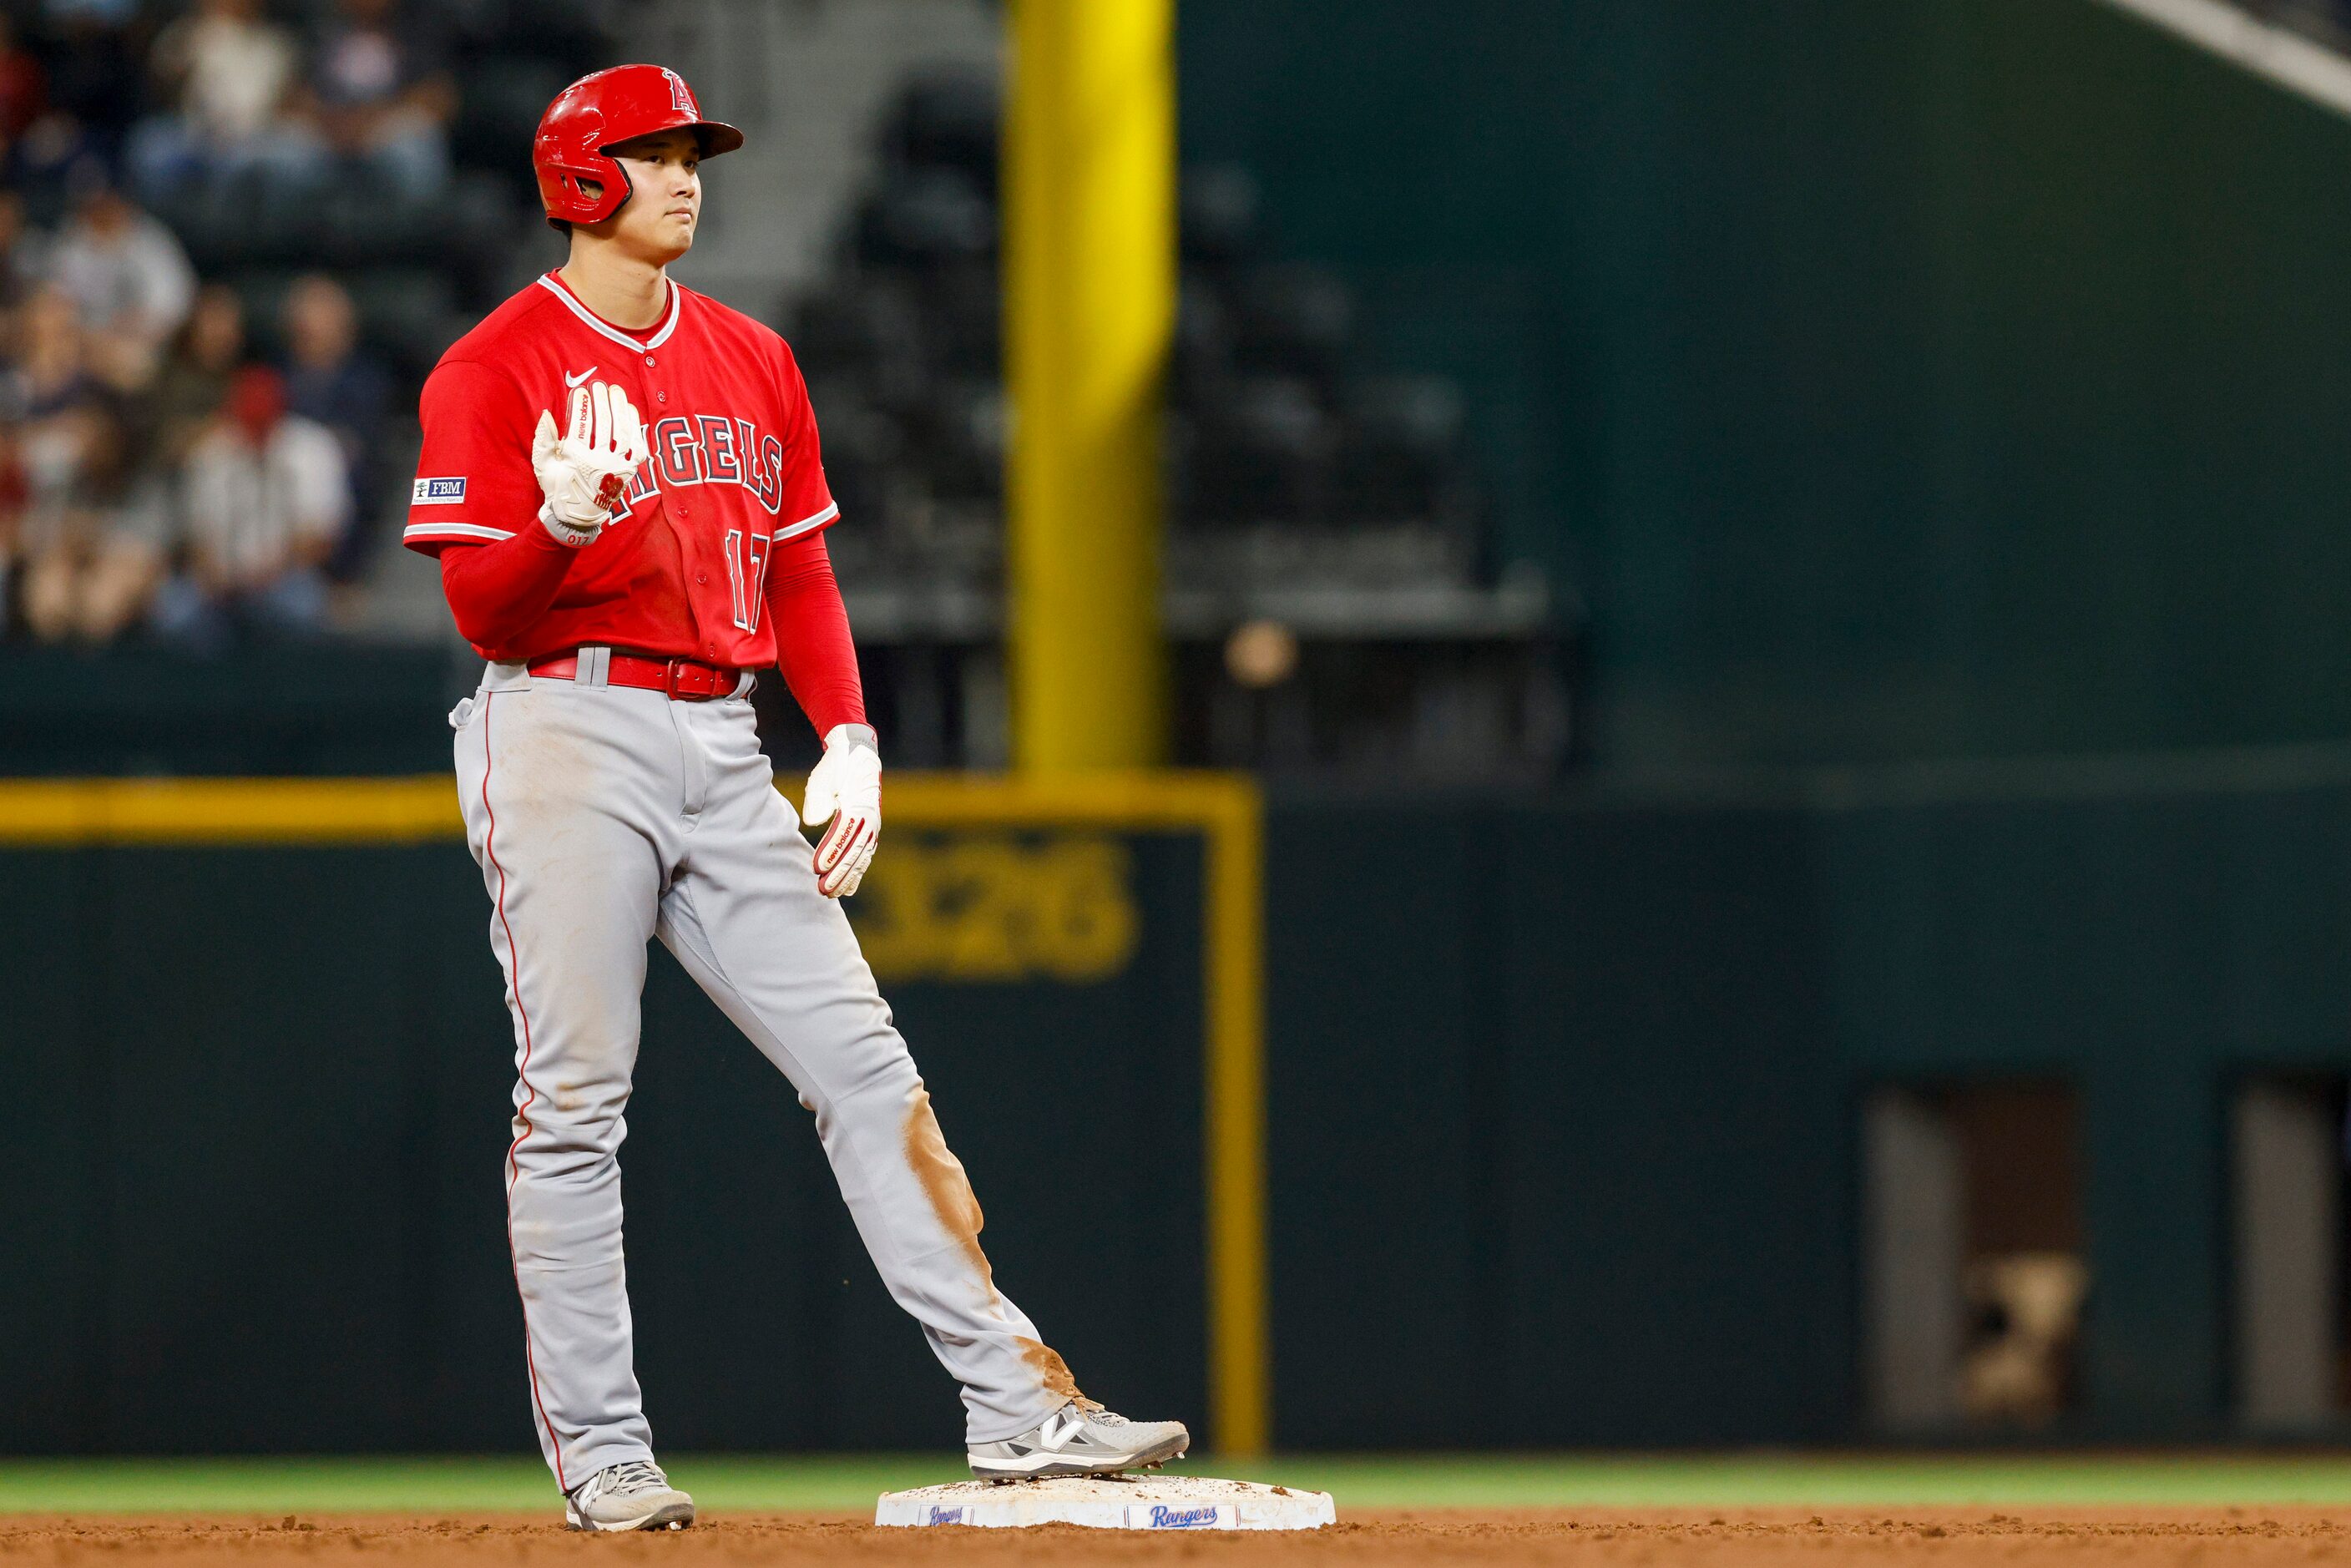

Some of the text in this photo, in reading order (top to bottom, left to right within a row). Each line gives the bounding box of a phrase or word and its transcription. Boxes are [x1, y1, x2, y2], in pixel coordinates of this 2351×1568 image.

[662, 67, 698, 114] A
[578, 394, 589, 439] new balance
[431, 481, 462, 495] FBM
[725, 529, 771, 635] 17
[827, 817, 856, 864] new balance
[1149, 1505, 1218, 1528] Rangers
